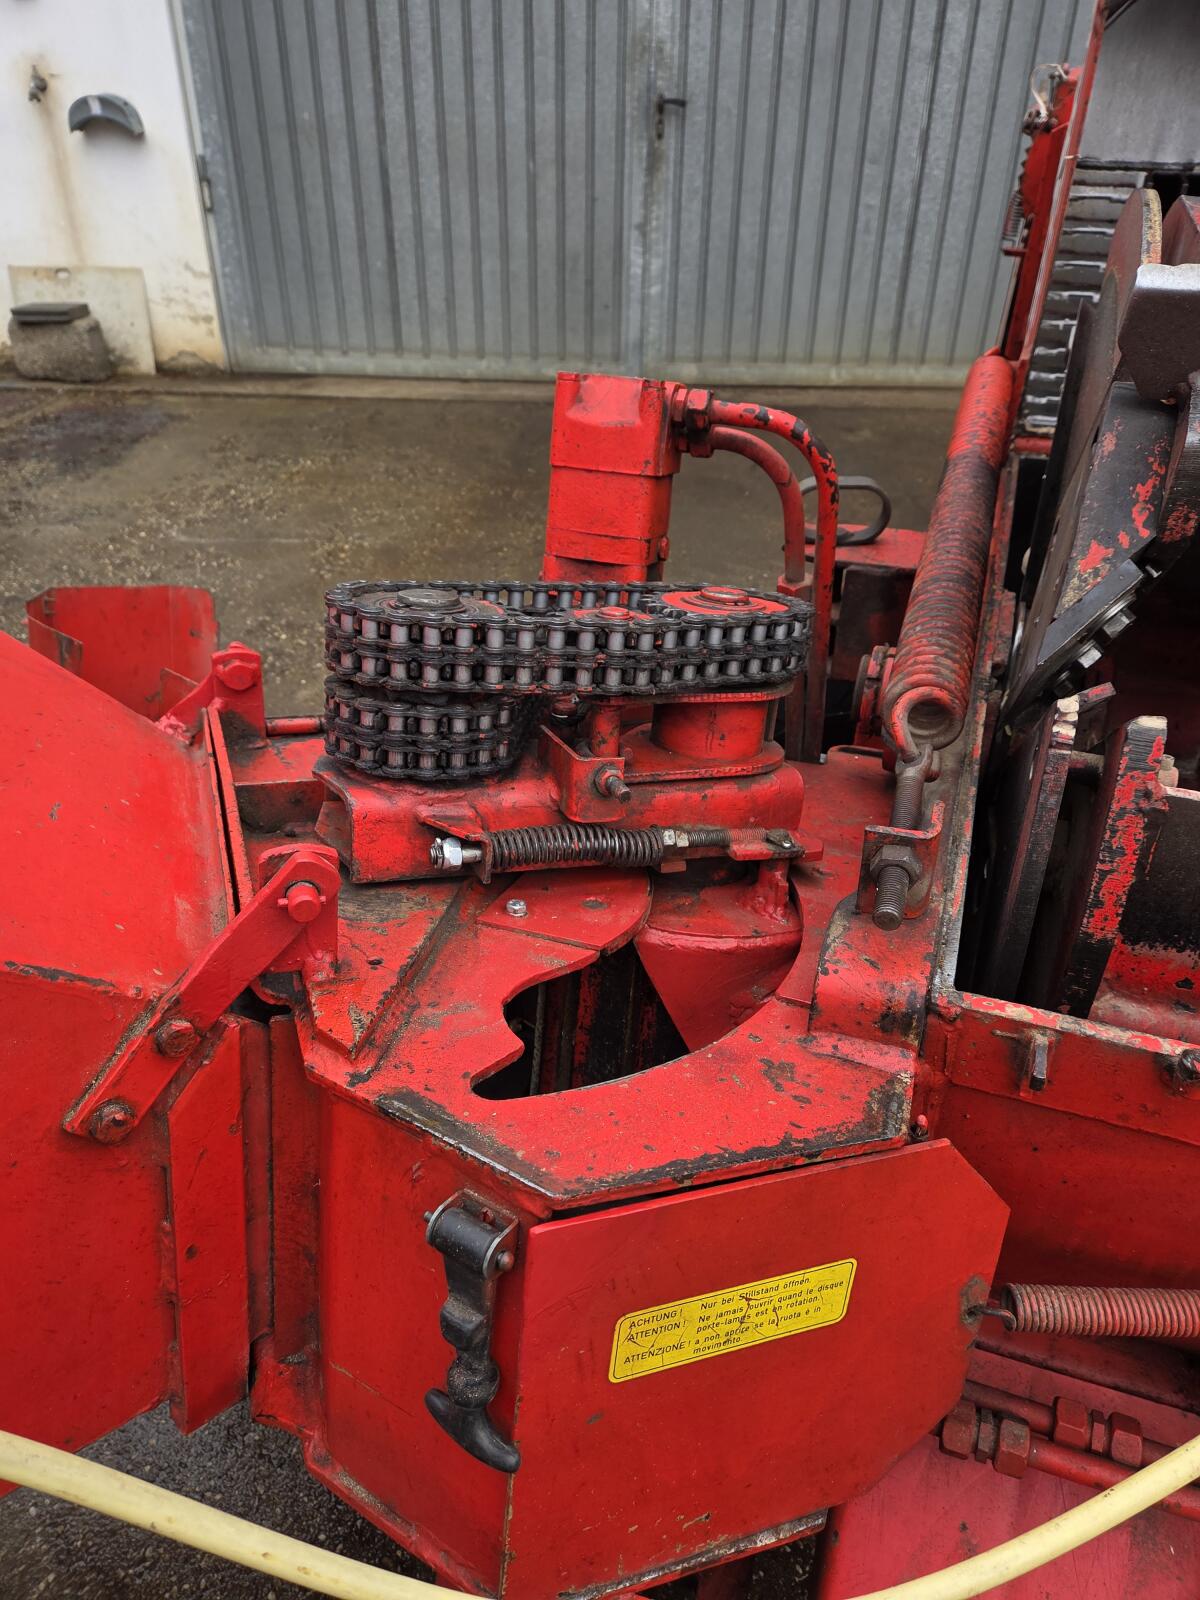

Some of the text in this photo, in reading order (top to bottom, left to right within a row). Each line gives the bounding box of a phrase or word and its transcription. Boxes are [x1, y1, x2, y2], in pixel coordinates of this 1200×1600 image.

[698, 1314, 711, 1323] Ne
[715, 1306, 744, 1320] jamais
[749, 1298, 774, 1310] ouvrir
[777, 1290, 803, 1303] quand
[817, 1280, 844, 1292] disque
[700, 1301, 717, 1310] Nur
[721, 1296, 735, 1305] bei
[738, 1284, 780, 1301] Stillstand
[755, 1308, 769, 1317] est
[772, 1304, 783, 1313] en
[786, 1295, 820, 1309] rotation.
[704, 1332, 720, 1342] non
[754, 1321, 764, 1329] se
[779, 1312, 801, 1322] ruota
